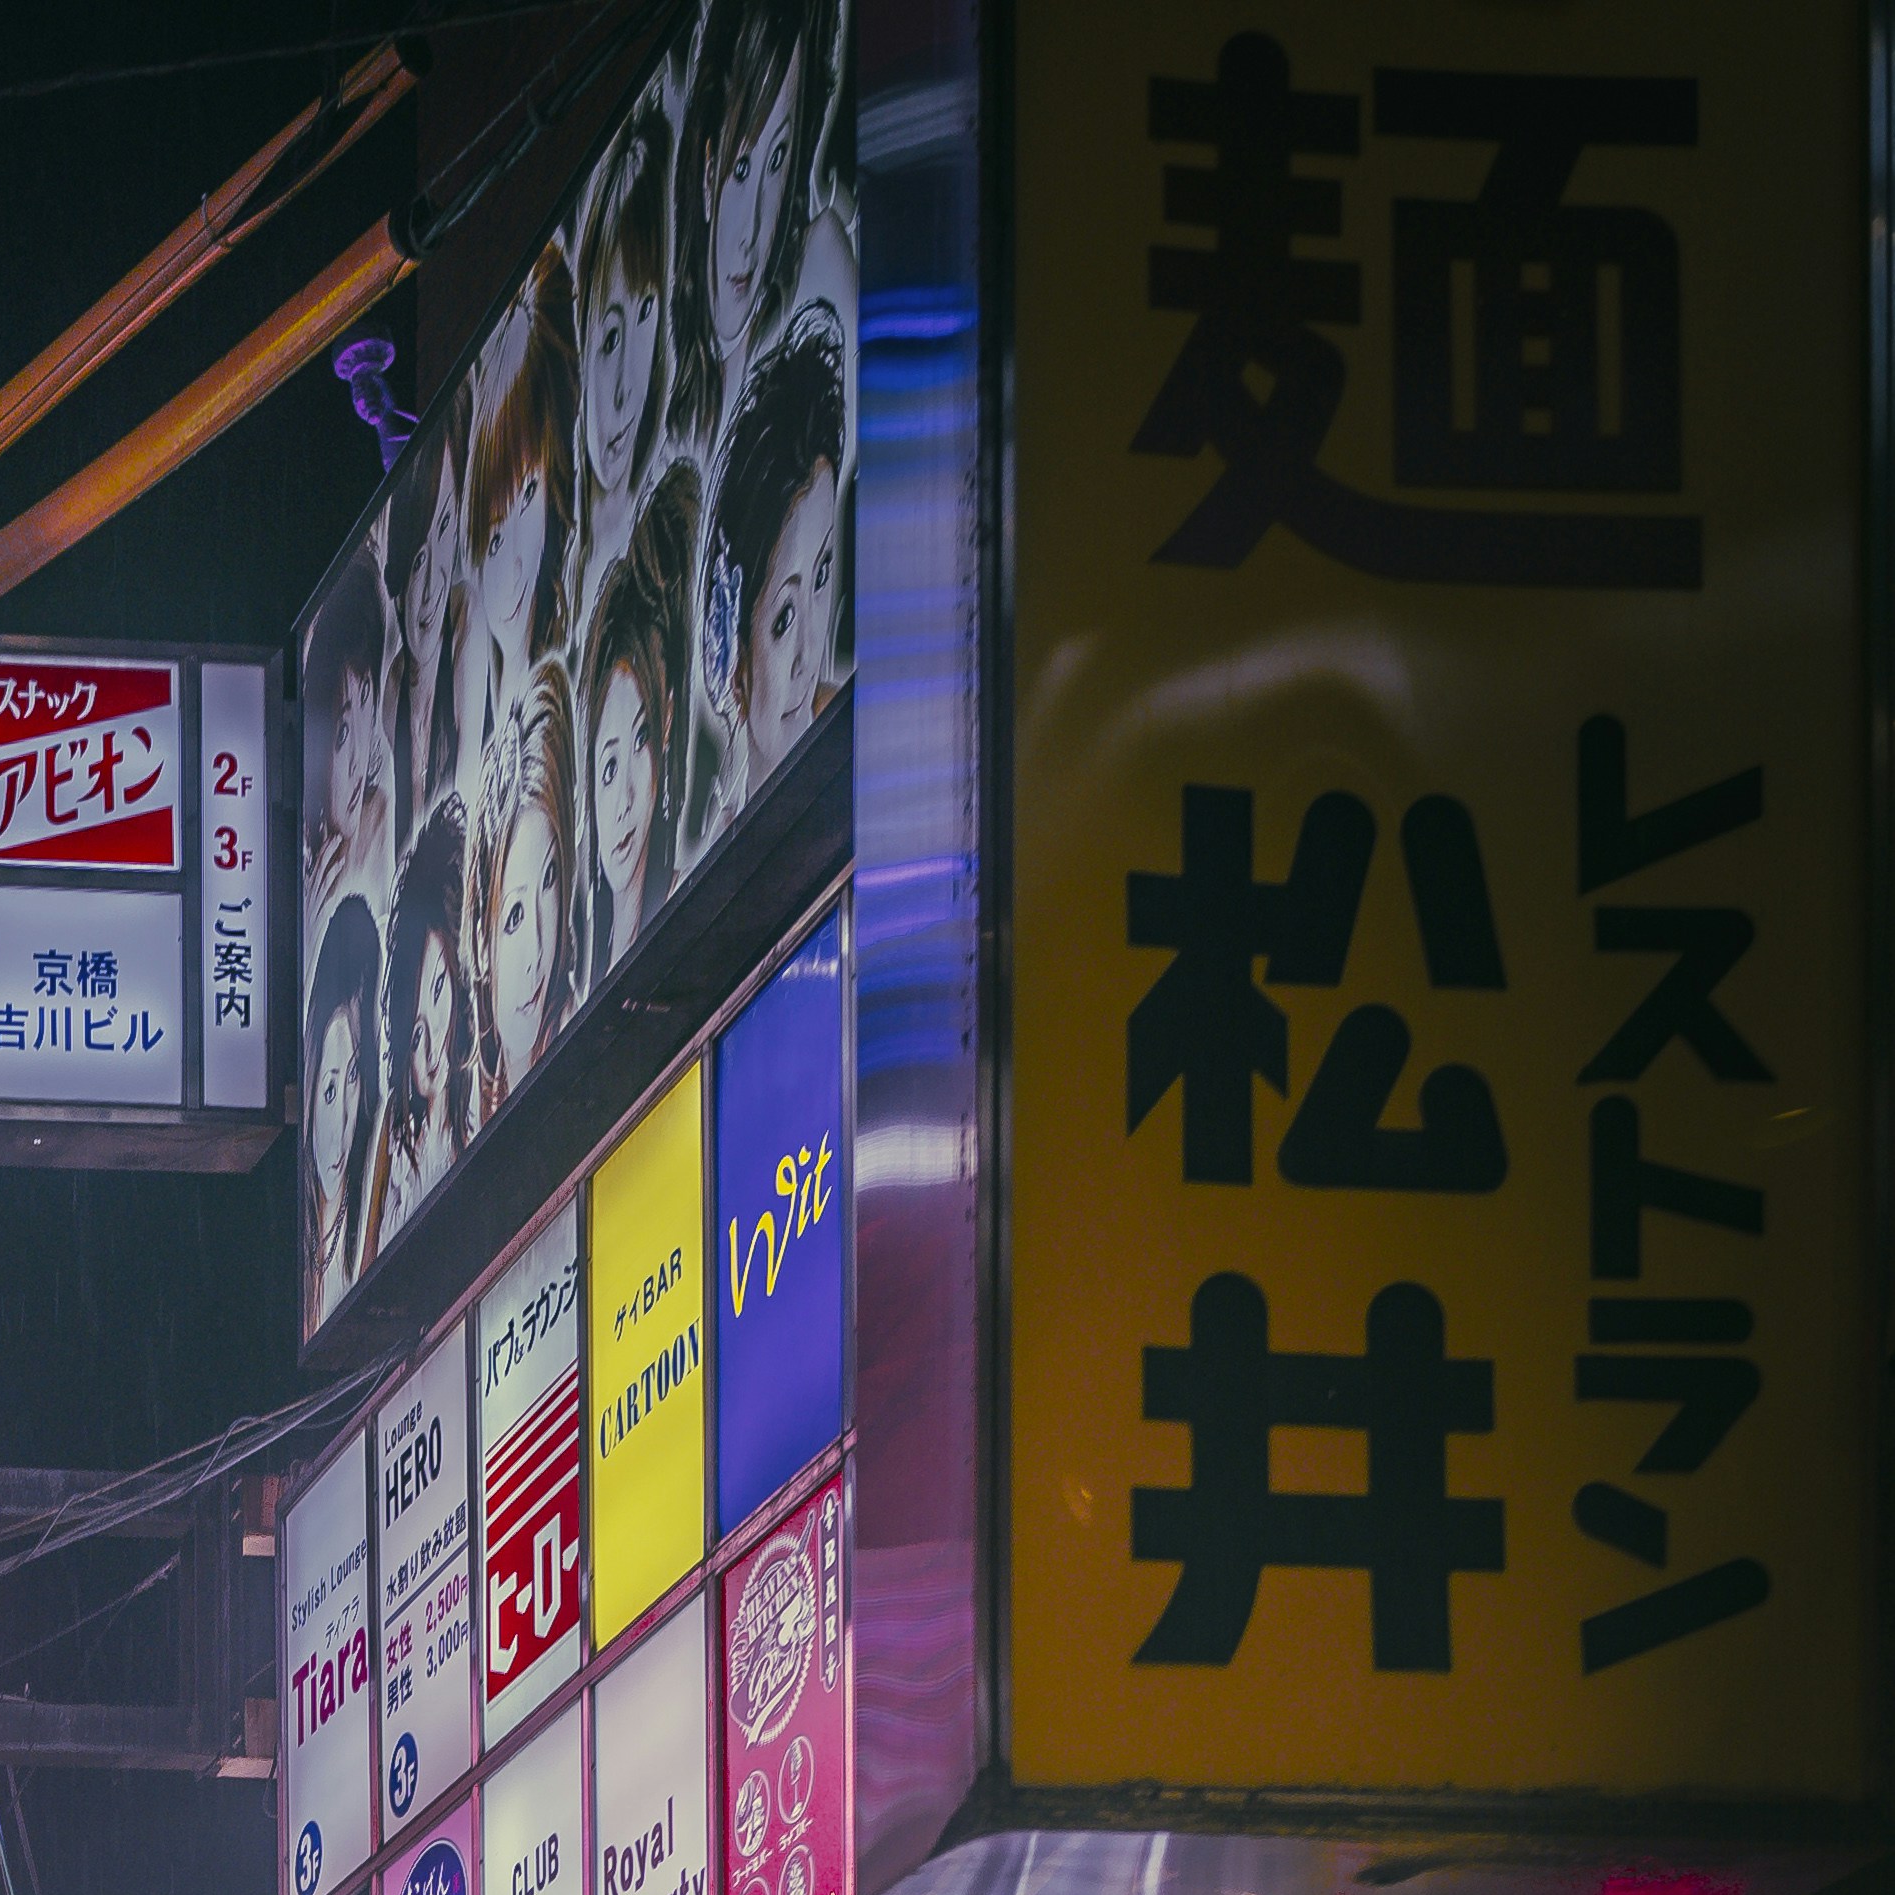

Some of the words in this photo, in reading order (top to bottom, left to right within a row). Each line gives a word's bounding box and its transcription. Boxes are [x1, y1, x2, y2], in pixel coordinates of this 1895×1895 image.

[212, 751, 254, 796] 2F
[212, 826, 254, 872] 3F
[32, 948, 119, 999] 京橋
[212, 898, 254, 1028] ご案内
[1126, 783, 1510, 1676] 松井
[1573, 712, 1777, 1678] レストラン
[614, 1246, 683, 1342] ゲイBAR
[384, 1400, 423, 1457] Lounge
[599, 1316, 702, 1460] CARTOON
[385, 1414, 443, 1531] HERO
[291, 1574, 327, 1632] Stylish
[329, 1537, 367, 1595] Lounge
[325, 1595, 360, 1649] ティアラ
[386, 1625, 413, 1674] 女性
[425, 1572, 469, 1634] 2,500円
[489, 1511, 579, 1675] ヒーロー
[824, 1540, 838, 1646] BAR
[292, 1624, 369, 1749] Tiara
[386, 1668, 414, 1720] 男性
[425, 1620, 469, 1679] 3,000円
[393, 1743, 417, 1808] 3F
[299, 1830, 320, 1886] 3F
